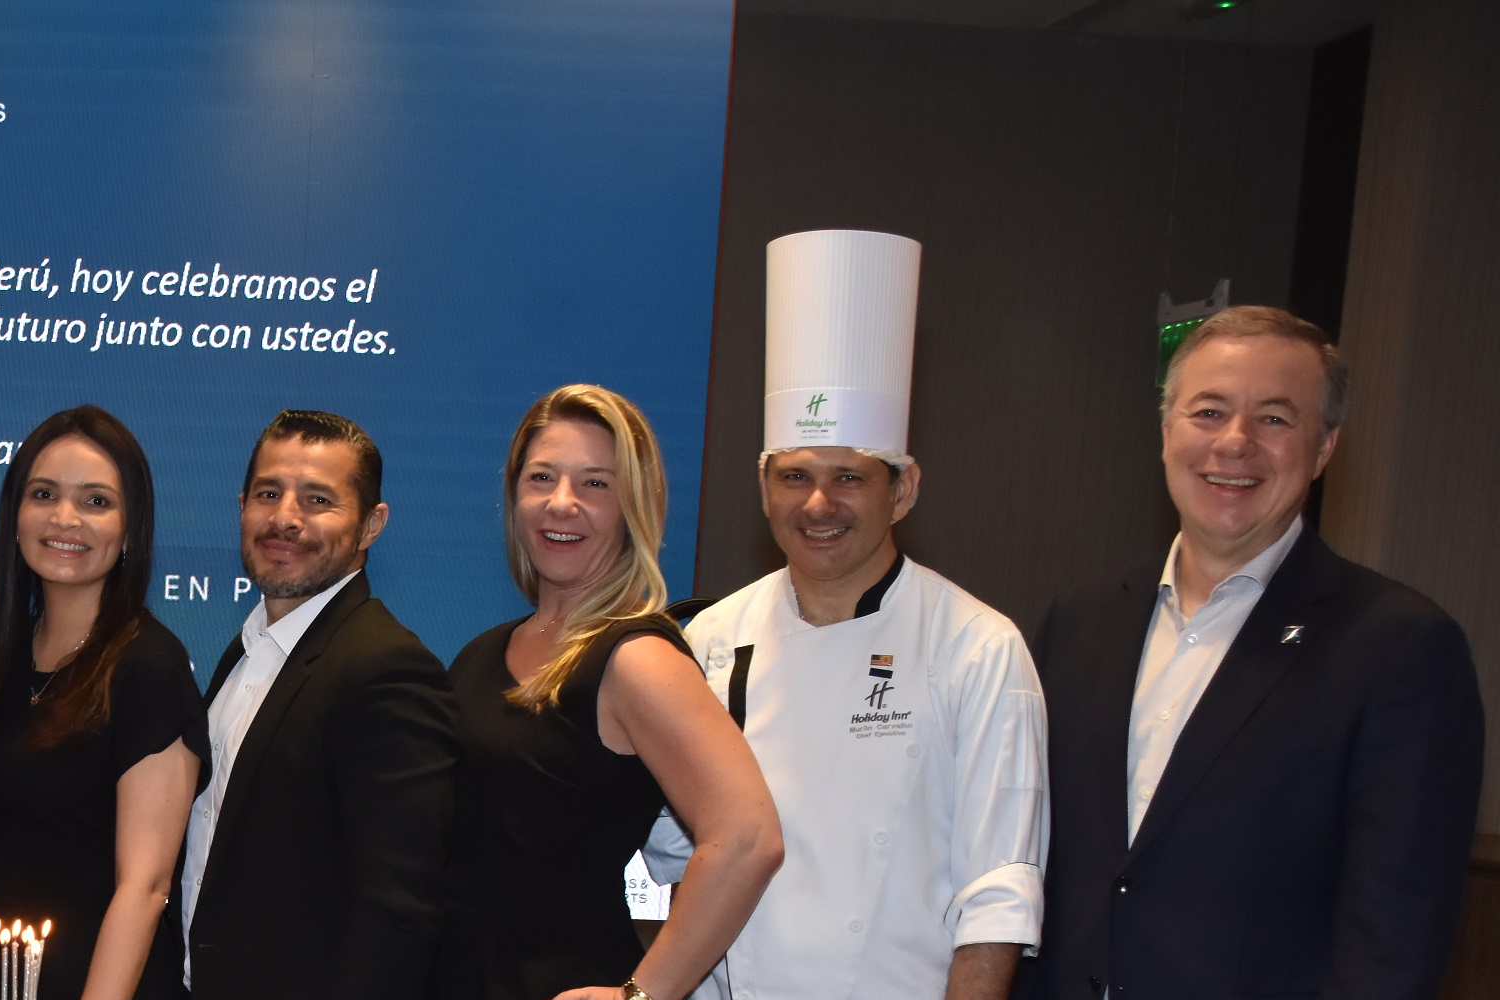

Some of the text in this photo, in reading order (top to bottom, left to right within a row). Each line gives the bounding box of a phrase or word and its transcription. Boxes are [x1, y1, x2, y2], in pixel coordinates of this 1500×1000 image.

[70, 258, 134, 302] hoy
[141, 261, 337, 302] celebramos
[345, 268, 379, 304] el
[90, 312, 183, 353] junto
[191, 322, 252, 350] con
[261, 318, 397, 356] ustedes.
[824, 418, 837, 427] Inn
[164, 574, 210, 601] EN
[851, 711, 890, 724] Holiday
